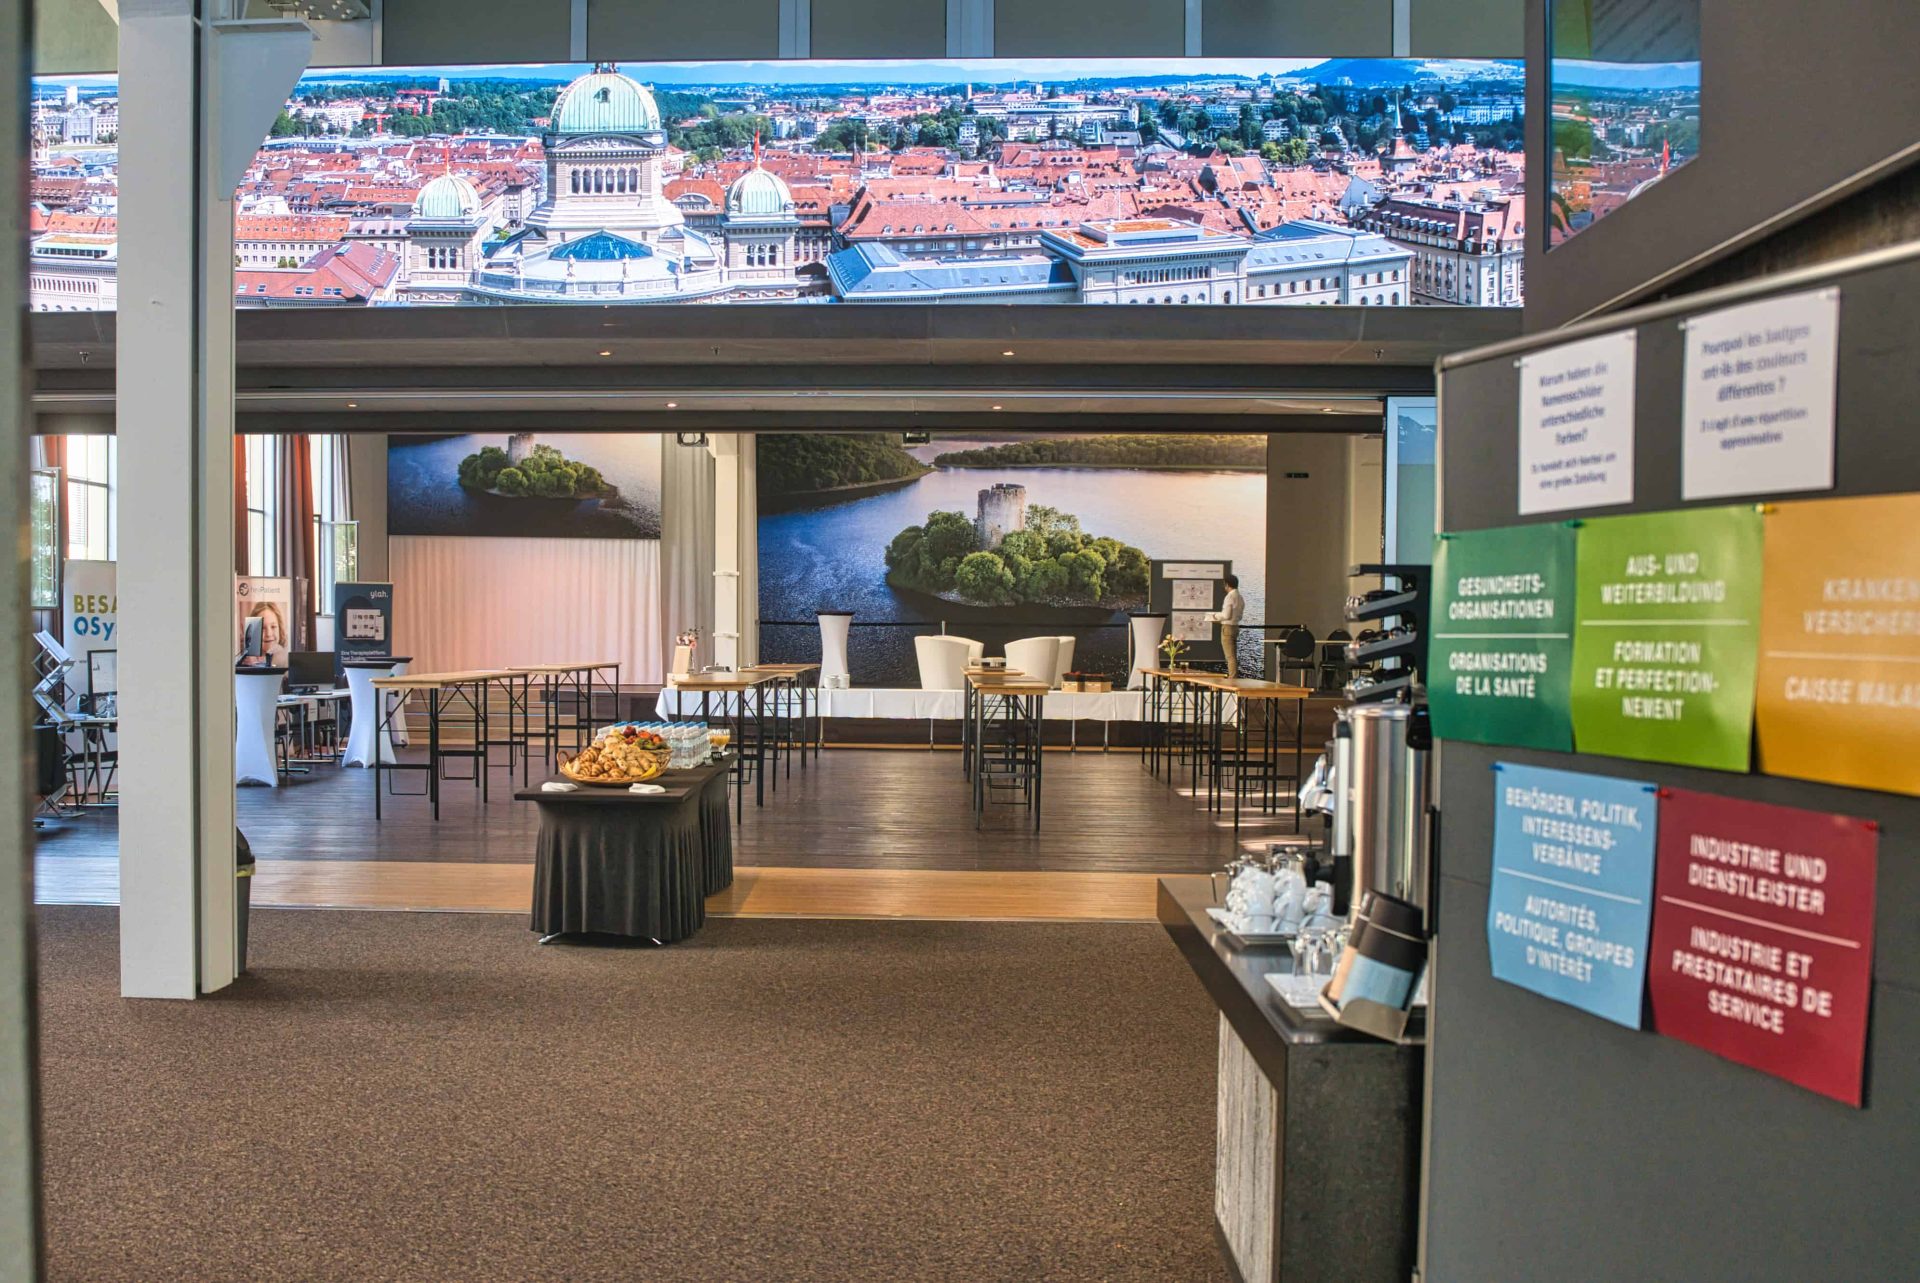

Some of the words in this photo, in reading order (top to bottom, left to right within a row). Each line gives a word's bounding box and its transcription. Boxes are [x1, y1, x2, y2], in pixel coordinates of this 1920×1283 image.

[1626, 554, 1662, 576] AUS-
[1665, 552, 1699, 575] UND
[1458, 573, 1545, 596] GESUNDHEITS-
[1601, 579, 1725, 604] WEITERBILDUNG
[1449, 599, 1554, 620] ORGANISATIONEN
[1449, 652, 1547, 673] ORGANISATIONS
[1614, 641, 1701, 664] FORMATION
[1456, 676, 1472, 694] DE
[1475, 676, 1491, 696] LA
[1493, 673, 1536, 698] SANTÉ
[1595, 667, 1614, 689] ET
[1617, 668, 1719, 693] PERFECTION-
[1785, 675, 1851, 704] CAISSE
[1622, 696, 1684, 720] NEMENT
[1505, 787, 1577, 819] BEHÖRDEN,
[1581, 799, 1642, 831] POLITIK,
[1521, 815, 1617, 850] INTERESSENS-
[1532, 842, 1602, 876] VERBÄNDE
[1690, 834, 1781, 875] INDUSTRIE
[1784, 853, 1827, 884] UND
[1688, 863, 1825, 915] DIENSTLEISTER
[1565, 931, 1634, 969] GROUPES
[1690, 926, 1782, 972] INDUSTRIE
[1785, 951, 1814, 980] ET
[1672, 950, 1799, 1007] PRESTATAIRES
[1801, 987, 1833, 1018] DE
[1707, 989, 1784, 1035] SERVICE
